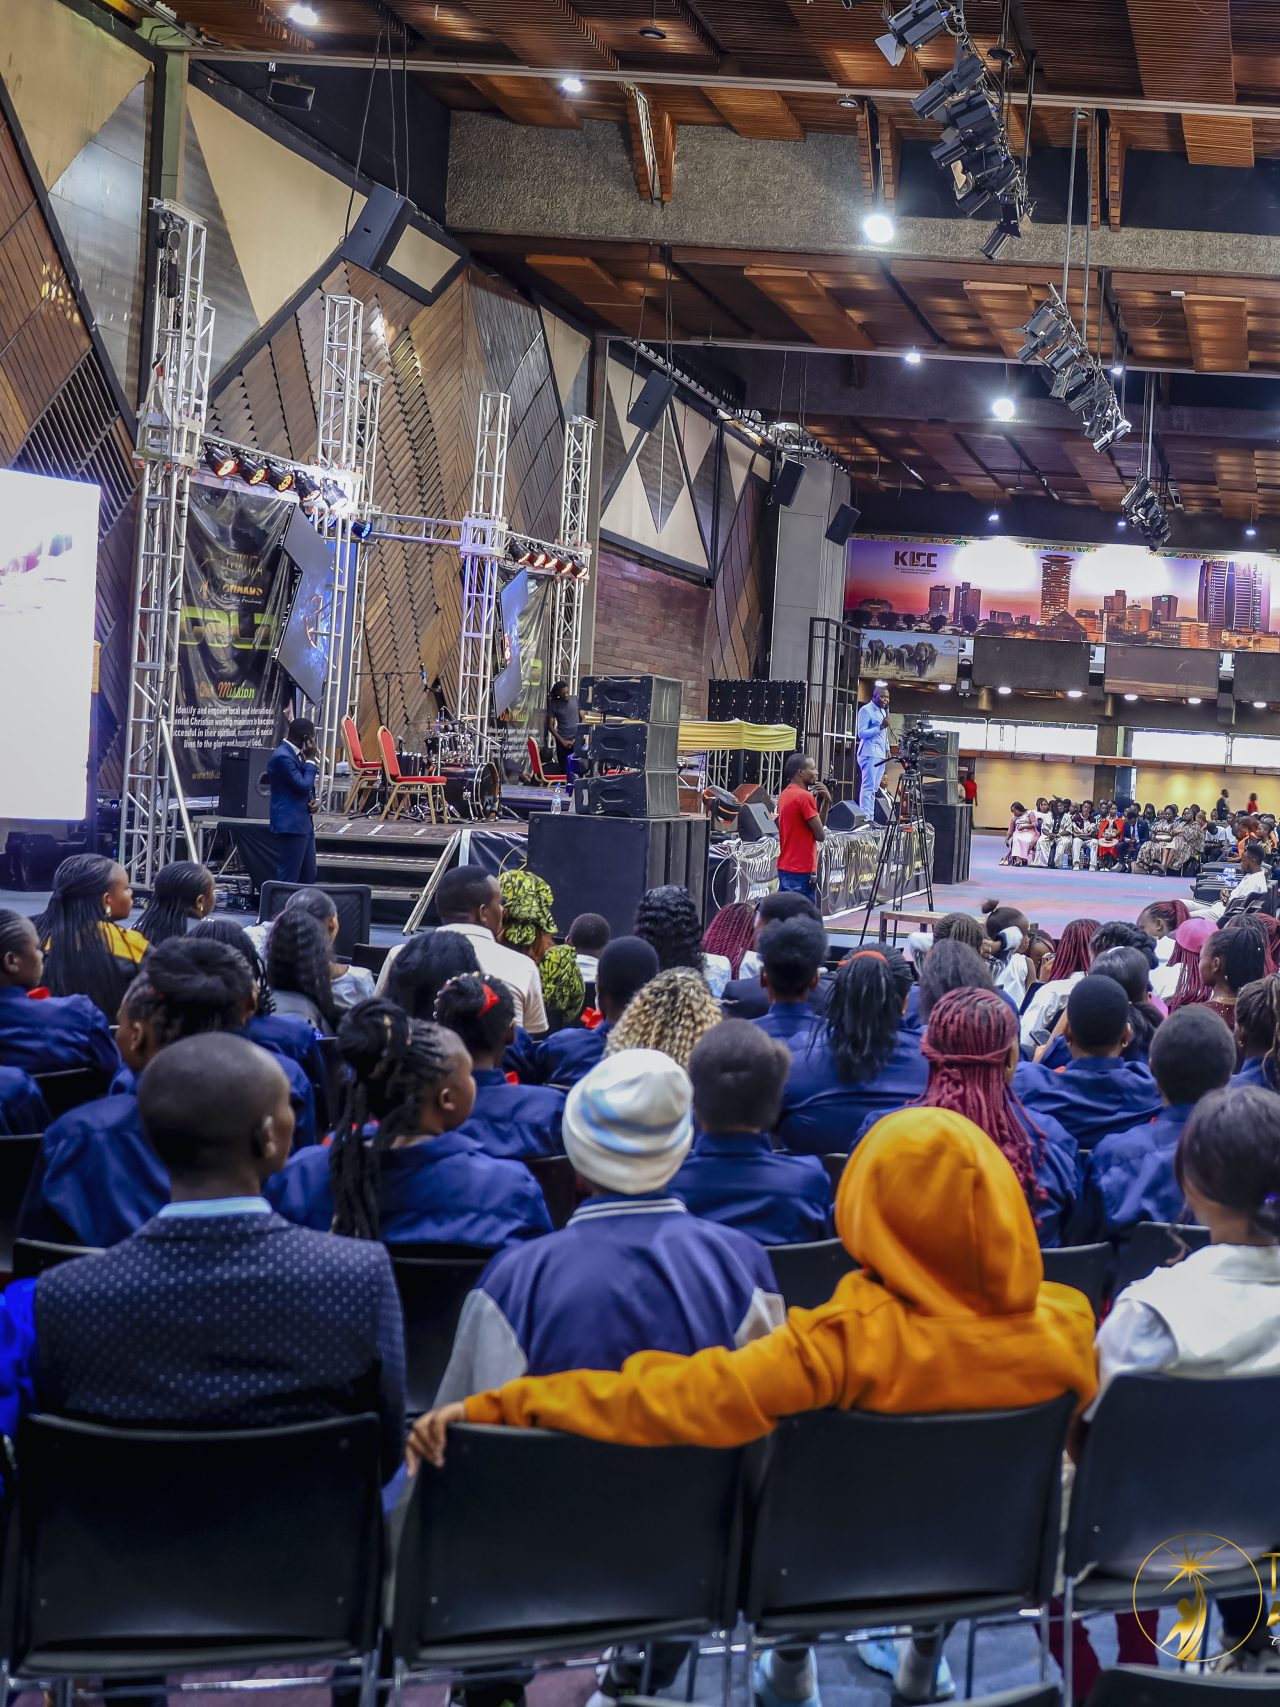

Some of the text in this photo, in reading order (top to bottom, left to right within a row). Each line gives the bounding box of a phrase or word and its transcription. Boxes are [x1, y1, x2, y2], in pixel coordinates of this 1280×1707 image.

[218, 681, 255, 699] Mission
[197, 706, 207, 715] and
[190, 717, 214, 726] Christian
[204, 728, 217, 737] their
[203, 739, 213, 748] the
